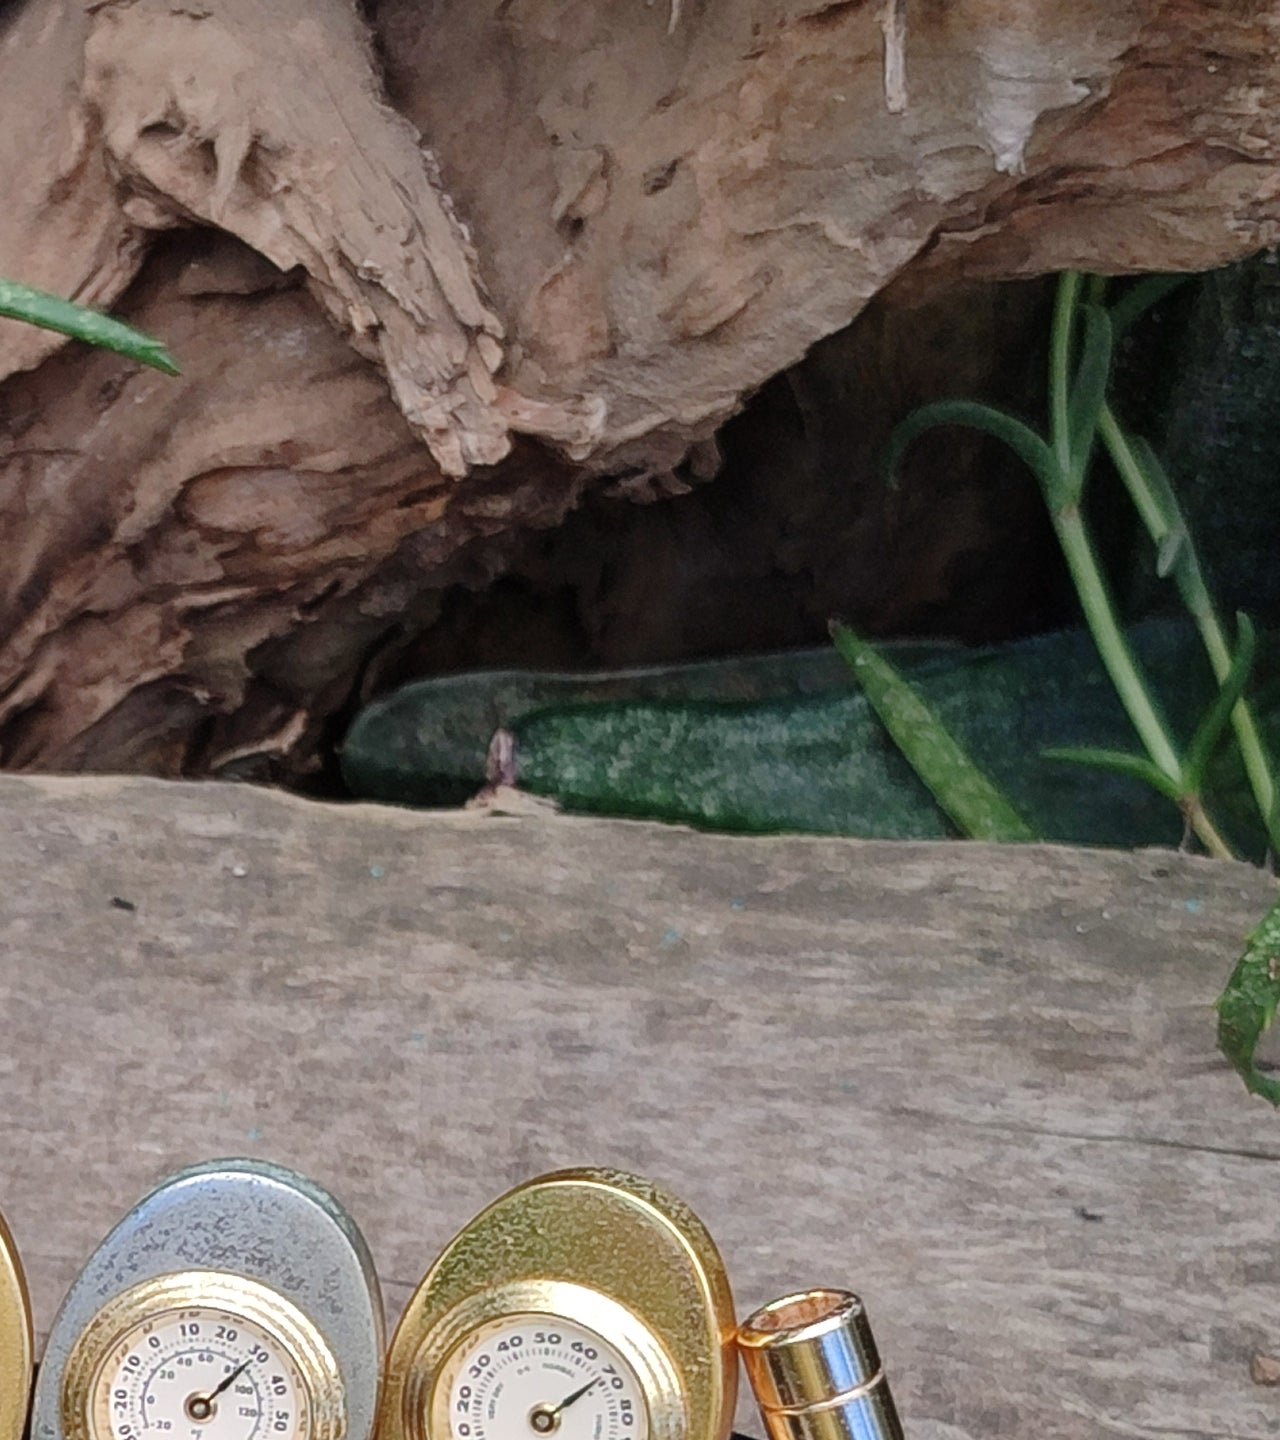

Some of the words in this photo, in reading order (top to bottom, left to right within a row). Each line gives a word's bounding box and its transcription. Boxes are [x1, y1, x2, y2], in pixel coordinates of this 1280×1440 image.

[179, 1323, 200, 1337] 10
[215, 1325, 238, 1343] 20
[534, 1332, 562, 1345] 50
[147, 1335, 162, 1349] 0
[497, 1335, 523, 1352] 40
[571, 1341, 599, 1361] 60
[248, 1343, 270, 1365] 30
[159, 1369, 176, 1380] 20
[468, 1354, 491, 1379] 30
[601, 1363, 624, 1391] 70
[270, 1374, 288, 1396] 40
[456, 1384, 472, 1413] 20
[273, 1410, 290, 1432] 50
[620, 1399, 634, 1427] 80
